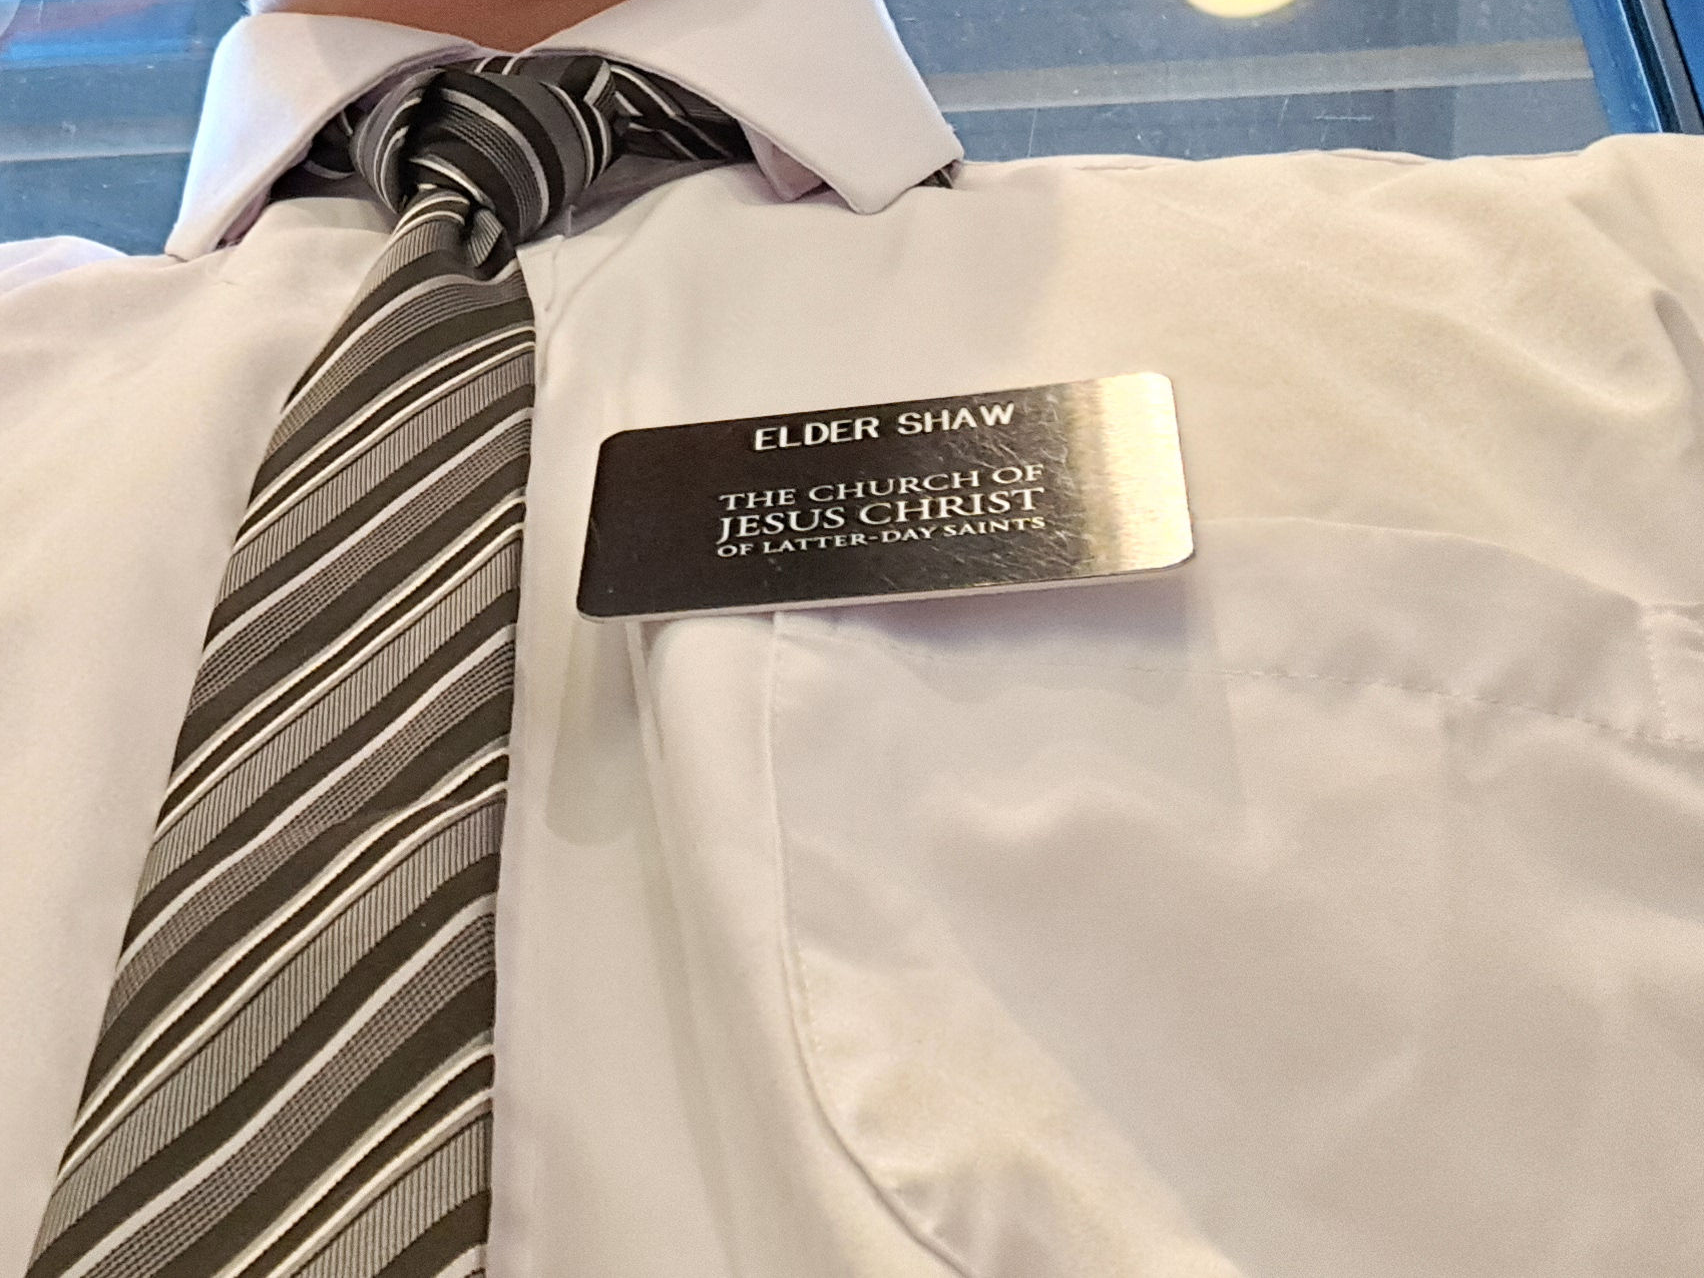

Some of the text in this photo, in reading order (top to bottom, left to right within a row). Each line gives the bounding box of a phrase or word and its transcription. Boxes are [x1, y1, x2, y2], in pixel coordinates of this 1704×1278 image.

[754, 402, 1016, 451] ELDER SHAW
[719, 463, 1045, 511] THE CHURCH OF
[716, 487, 1045, 545] JESUS CHRIST
[717, 516, 1046, 558] OF LATTER-DAY SAINTS
